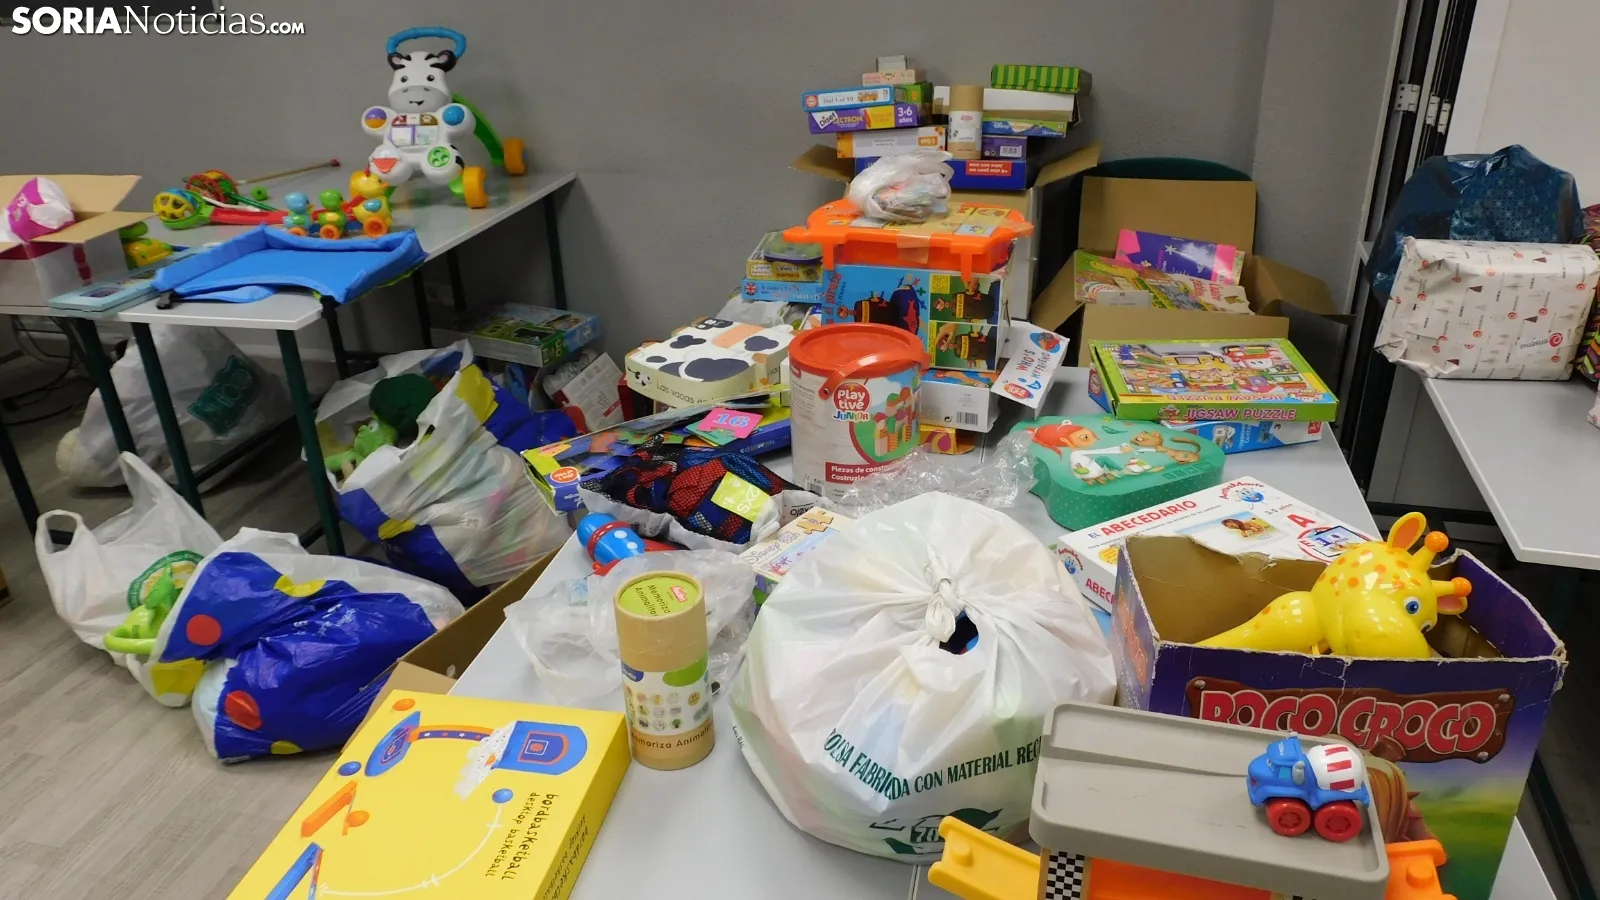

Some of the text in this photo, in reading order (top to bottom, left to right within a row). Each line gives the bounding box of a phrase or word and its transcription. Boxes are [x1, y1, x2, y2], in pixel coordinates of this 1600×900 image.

[819, 112, 836, 127] Diset
[834, 115, 862, 124] ECTRON
[1016, 349, 1036, 371] WHO'S
[656, 381, 695, 404] Las vacas
[837, 389, 866, 401] Play
[838, 400, 865, 411] tive
[1184, 408, 1296, 420] JIGSAW PUZZLE
[714, 413, 750, 427] 16
[833, 411, 870, 421] JUNIOR
[831, 465, 854, 474] Piezas
[855, 465, 864, 473] de
[1088, 531, 1101, 539] EL
[1100, 500, 1197, 537] ABECEDARIO
[647, 584, 671, 614] Memoriza
[1337, 696, 1497, 755] CROCO
[824, 728, 855, 768] OLSA
[914, 769, 943, 793] CON
[947, 750, 1013, 785] MATERIAL
[485, 791, 540, 877] desktop basketball
[501, 793, 560, 880] bordbasketball
